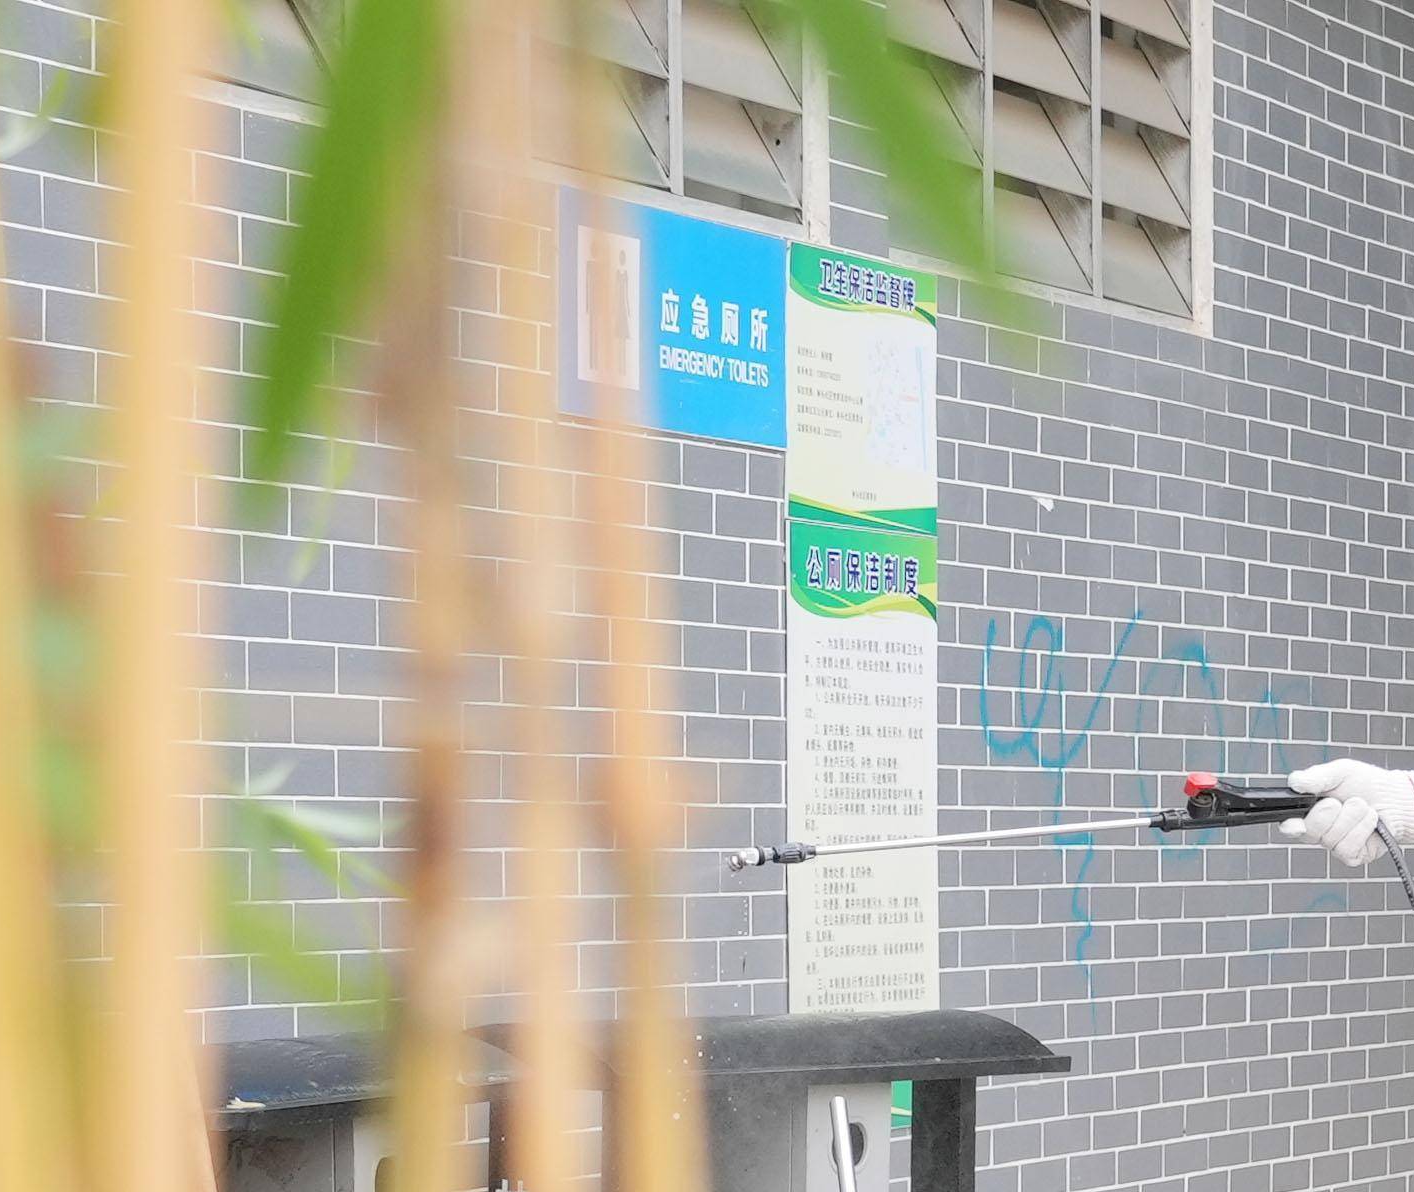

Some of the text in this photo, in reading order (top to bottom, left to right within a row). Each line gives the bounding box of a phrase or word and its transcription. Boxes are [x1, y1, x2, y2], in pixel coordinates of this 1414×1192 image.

[818, 258, 917, 312] 卫生保洁监督牌
[660, 288, 768, 352] 应急厕所
[659, 344, 725, 378] EMERGENCY
[726, 357, 769, 388] TOILETS
[806, 545, 920, 599] 公厕保洁制度
